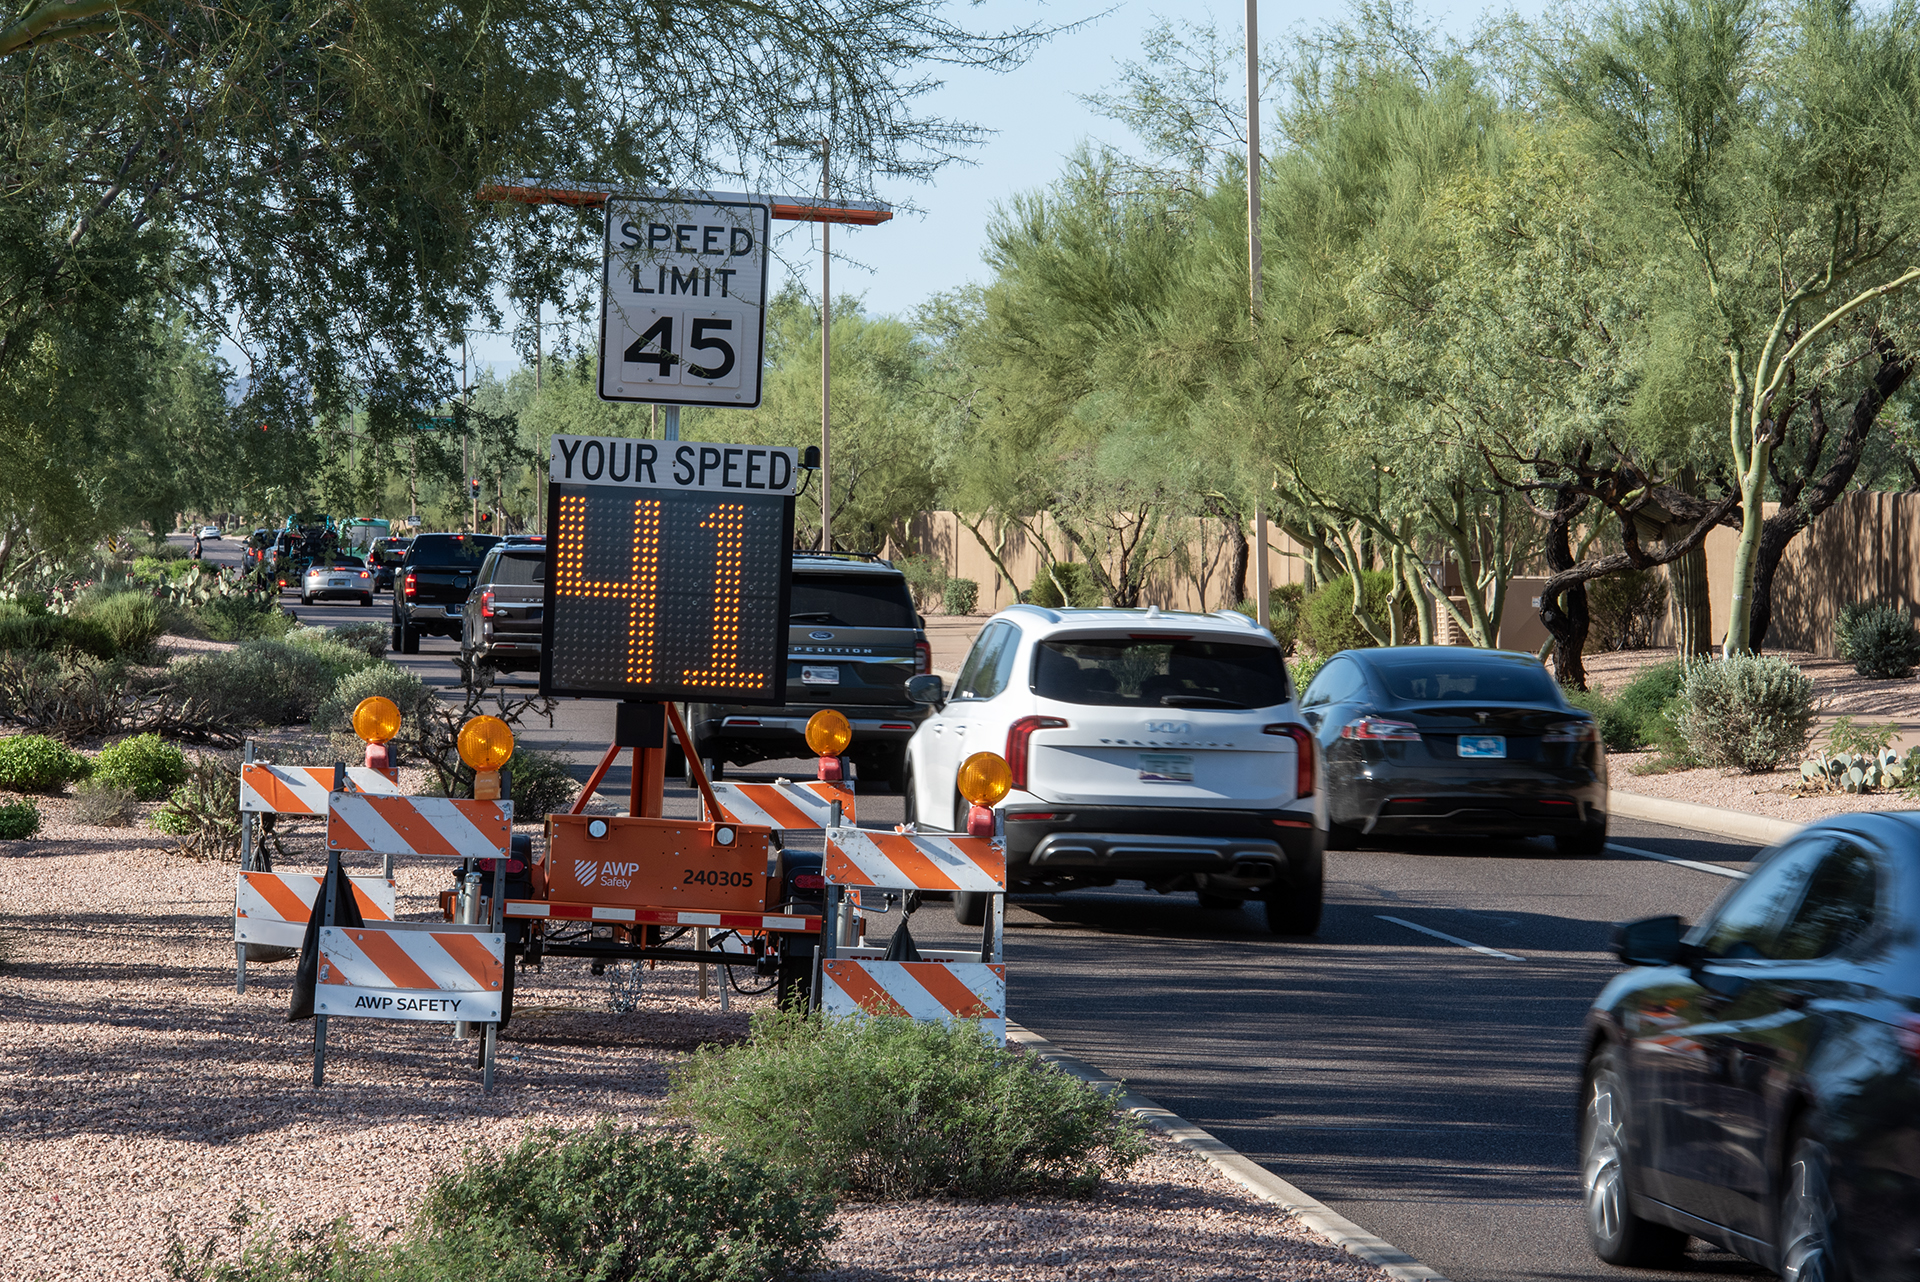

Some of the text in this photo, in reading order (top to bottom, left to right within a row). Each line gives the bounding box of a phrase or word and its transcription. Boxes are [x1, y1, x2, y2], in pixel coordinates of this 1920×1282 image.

[619, 221, 753, 257] SPEED
[632, 264, 737, 298] LIMIT
[623, 316, 736, 380] 45
[557, 438, 792, 491] YOUR SPEED
[556, 495, 764, 689] 41
[789, 646, 872, 654] PEDITION
[601, 861, 640, 877] AWP
[683, 868, 754, 888] 240305
[600, 876, 632, 890] Safety
[354, 995, 462, 1012] AWP SAFETY
